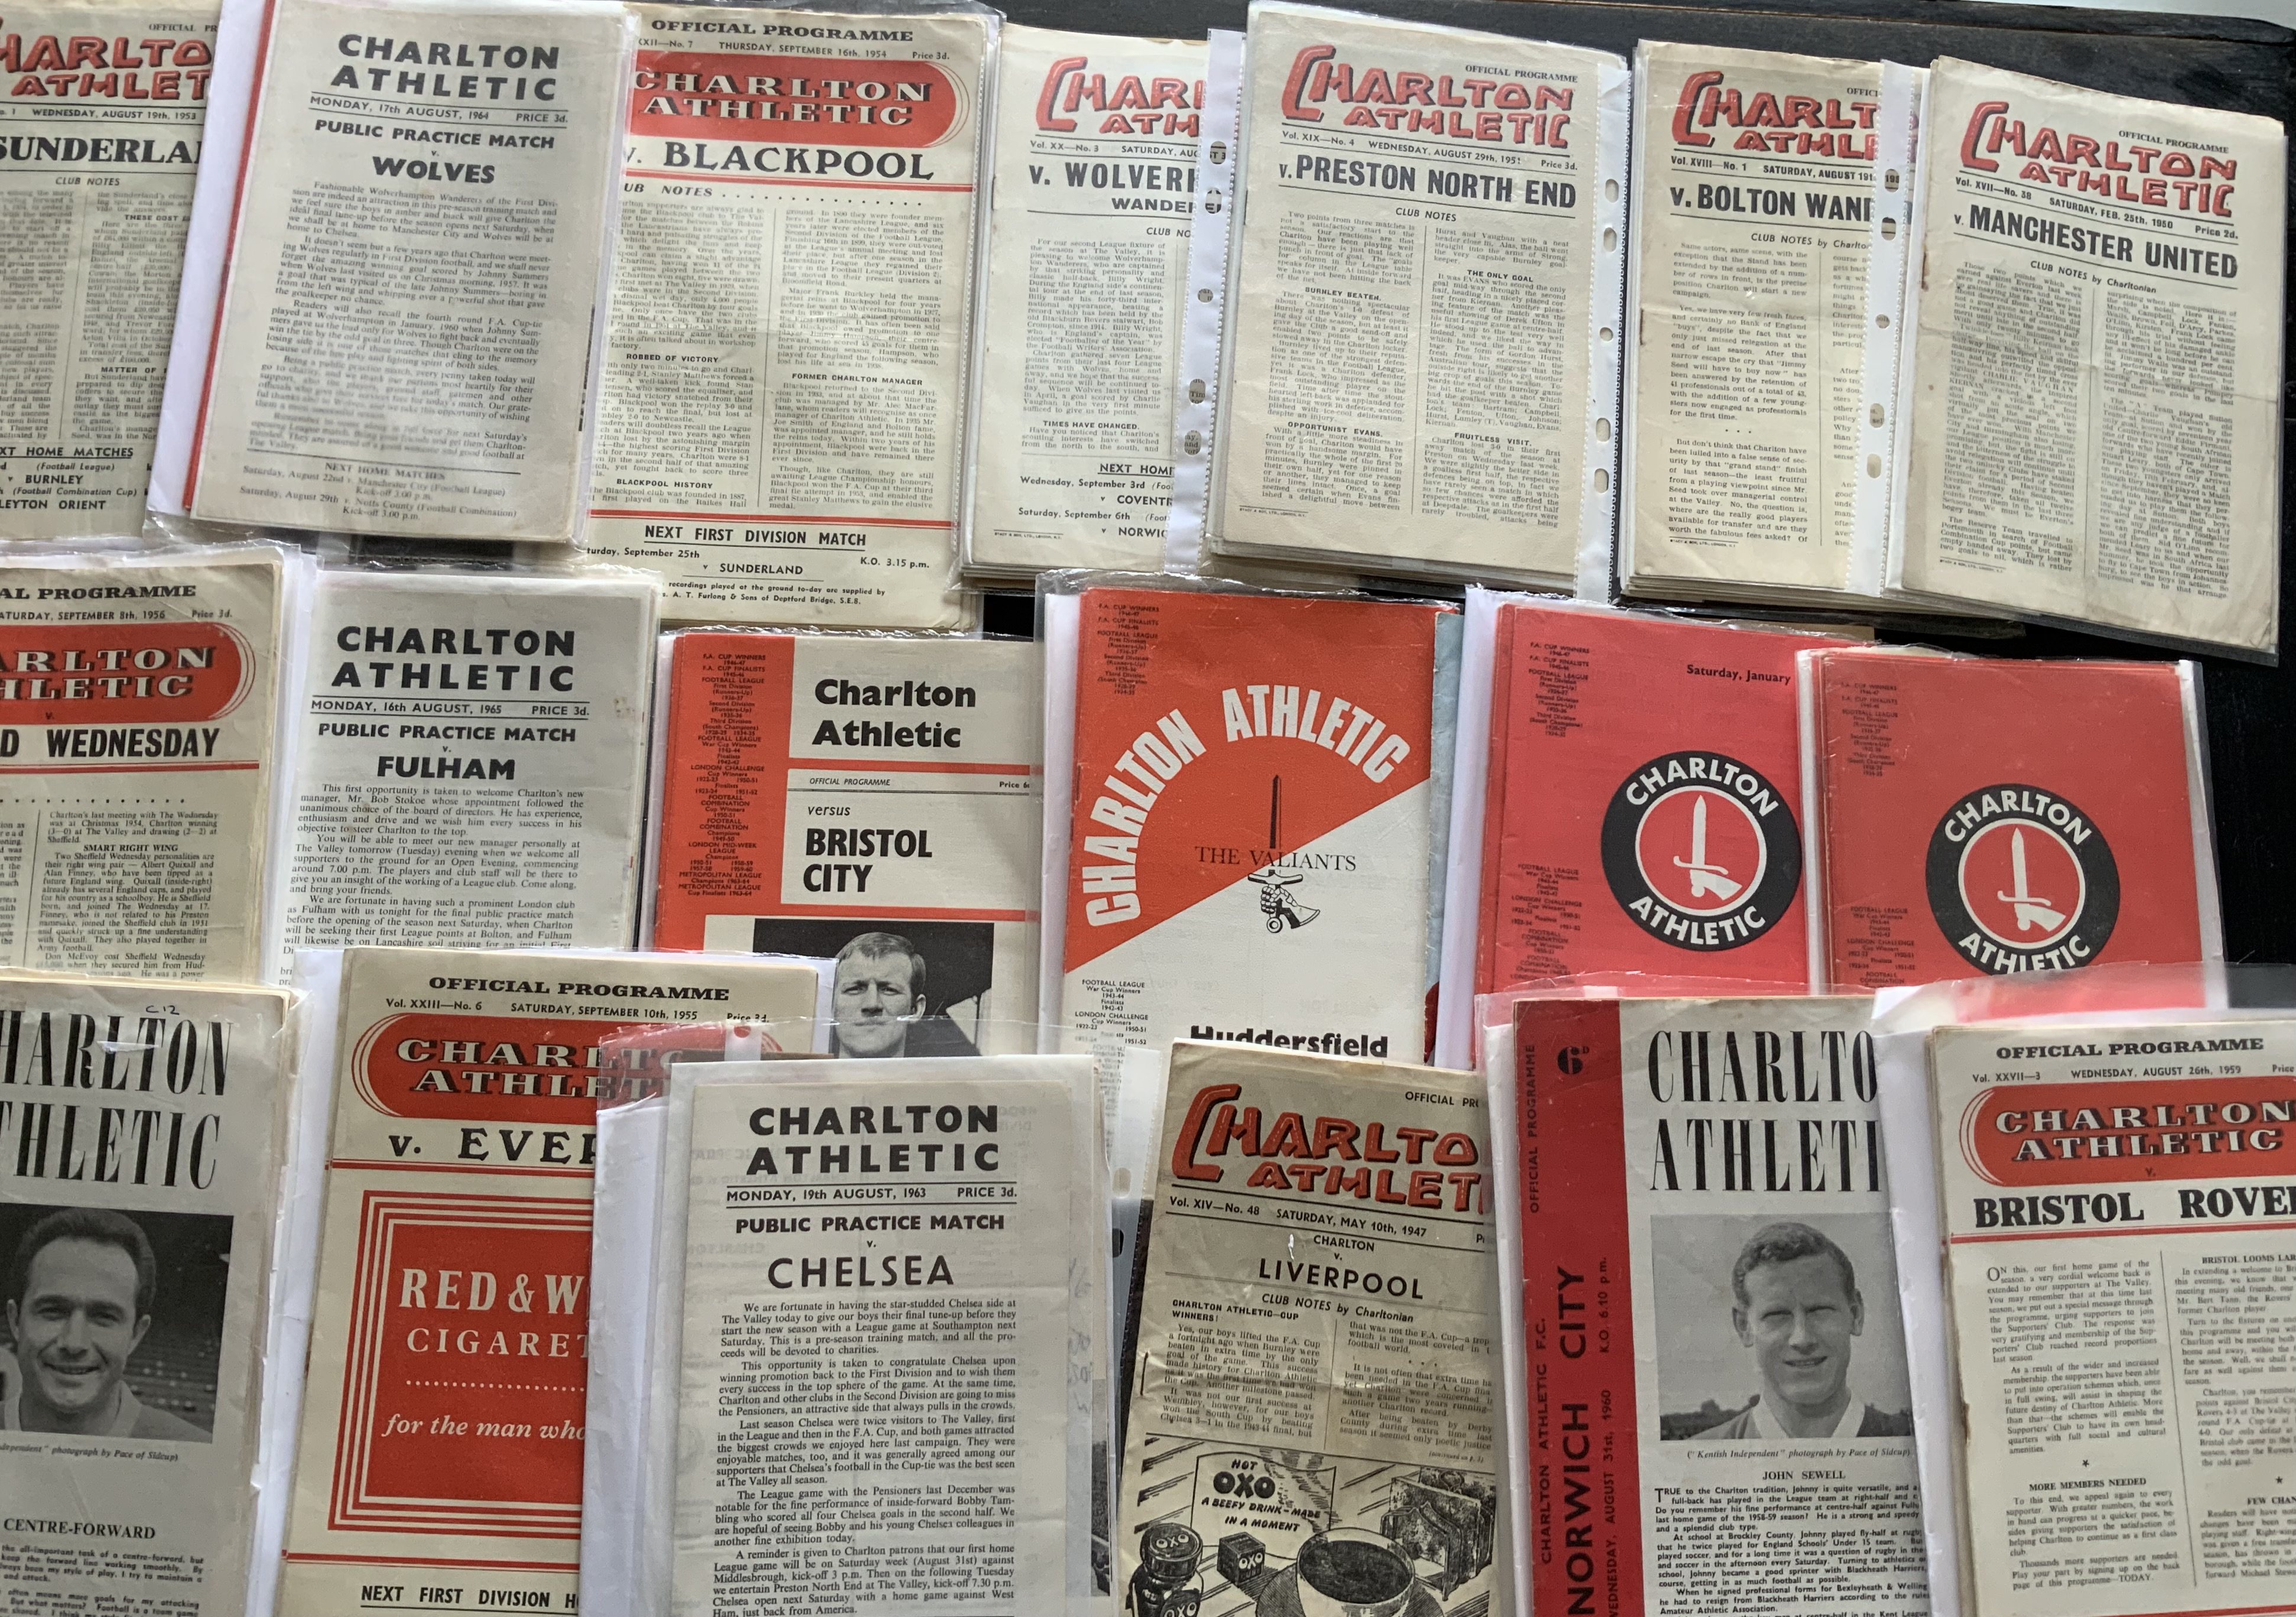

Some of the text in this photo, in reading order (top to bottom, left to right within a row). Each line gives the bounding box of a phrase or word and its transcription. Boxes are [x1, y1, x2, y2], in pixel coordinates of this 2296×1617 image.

[651, 20, 913, 43] OFFICIAL PROGRAMME
[339, 34, 560, 70] CHARLTON
[719, 41, 832, 57] THURSDAY, SEPTEMBER
[330, 65, 556, 101] ATHLETIC
[632, 70, 932, 102] CHARLTON
[1281, 44, 1574, 123] CHARLTON
[1465, 64, 1578, 83] OFFICIAL PROGRAMME
[33, 108, 99, 119] WEDNESDAY,
[310, 96, 568, 123] MONDAY, AUGUST, PRICE 3d.
[643, 96, 913, 126] ATHLETIC
[315, 119, 555, 149] PUBLIC PRACTICE MATCH
[1343, 106, 1570, 148] ATHLETIC
[1960, 100, 2238, 180] CHARLTON
[2118, 129, 2230, 154] OFFICIAL PROGRAMME
[664, 141, 934, 181] BLACKPOOL
[1368, 141, 1578, 171] WEDNESDAY, Price 3d.
[372, 156, 496, 184] WOLVES
[1279, 154, 1576, 209] v. PRESTON NORTH END
[1671, 184, 1795, 216] v. BOLTON
[2019, 161, 2235, 217] ATHLETIC
[1396, 207, 1456, 222] CLUB NOTES
[2049, 197, 2097, 216] SATURDAY,
[1969, 204, 2239, 279] MANCHESTER UNITED
[2030, 260, 2157, 294] CLUB NOTES Charltonian
[626, 353, 660, 362] ROBBED
[680, 355, 719, 363] VICTORY
[792, 373, 923, 386] FORMER CHARLTON MANAGER
[26, 447, 134, 458] HOME MATCHES
[25, 475, 83, 485] BURNLEY
[1020, 476, 1145, 489] Wednesday, September 3rd
[59, 501, 106, 510] ORIENT
[645, 525, 867, 547] NEXT FIRST DIVISION MATCH
[720, 563, 804, 576] SUNDERLAND
[37, 585, 196, 600] PROGRAMME
[698, 592, 808, 603] Furlong Deptford
[337, 626, 575, 657] CHARLTON
[331, 662, 573, 692] ATHLETIC
[1686, 664, 1791, 686] Saturday, January
[815, 678, 976, 707] Charlton
[311, 700, 473, 714] MONDAY, AUGUST,
[47, 728, 219, 758] WEDNESDAY
[318, 723, 575, 742] PUBLIC PRACTICE MATCH
[811, 720, 961, 748] Athletic
[378, 756, 515, 780] FULHAM
[1625, 756, 1779, 817] CHARLTON
[808, 805, 850, 817] versus
[1082, 709, 1207, 927] CHARLTON
[1222, 684, 1410, 784] ATHLETIC
[1944, 790, 2093, 846] CHARLTON
[806, 828, 932, 858] BRISTOL
[1195, 846, 1357, 872] THE VALIANTS
[803, 863, 873, 892] CITY
[1628, 895, 1766, 945] ATHLETIC
[430, 976, 729, 1001] OFFICIAL PROGRAMME
[1996, 1038, 2264, 1059] OFFICIAL PROGRAMME
[2071, 1067, 2183, 1079] WEDNESDAY, AUGUST
[750, 1105, 999, 1136] CHARLTON
[1995, 1099, 2295, 1134] CHARLTON
[389, 1134, 421, 1157] v.
[2012, 1129, 2283, 1161] ATHLETIC
[746, 1143, 999, 1176] ATHLETIC
[727, 1187, 1017, 1202] MONDAY, AUGUST, PRICE 3d.
[1276, 1209, 1336, 1227] SATURDAY,
[1973, 1193, 2145, 1228] BRISTOL
[736, 1215, 1004, 1234] PUBLIC PRACTICE MATCH
[1314, 1235, 1375, 1252] CHARLTON
[768, 1256, 954, 1288] CHELSEA
[1259, 1258, 1423, 1299] LIVERPOOL
[399, 1268, 497, 1310] RED
[744, 1303, 759, 1312] We
[780, 1302, 822, 1311] fortunate
[826, 1301, 835, 1310] in
[839, 1301, 869, 1311] having
[873, 1300, 886, 1308] the
[890, 1299, 945, 1308] star-studded
[949, 1298, 983, 1307] Chelsea
[987, 1299, 1004, 1307] side
[1356, 1306, 1413, 1323] Charltonian
[382, 1414, 423, 1439] for
[430, 1415, 467, 1436] the
[476, 1421, 531, 1438] man
[1558, 1266, 1594, 1615] NORWICH CITY
[1231, 1459, 1257, 1470] HOT
[1538, 1363, 1552, 1564] CHARLTON ATHLETIC
[1763, 1470, 1845, 1480] JOHN SEWELL
[1213, 1472, 1276, 1498] OXO
[2030, 1478, 2147, 1492] MORE MEMBERS NEEDED
[4, 1518, 155, 1540] CENTRE-FORWARD
[1253, 1519, 1299, 1531] MOMENT
[1156, 1534, 1188, 1548] OXO
[362, 1585, 550, 1607] NEXT FIRST DIVISION
